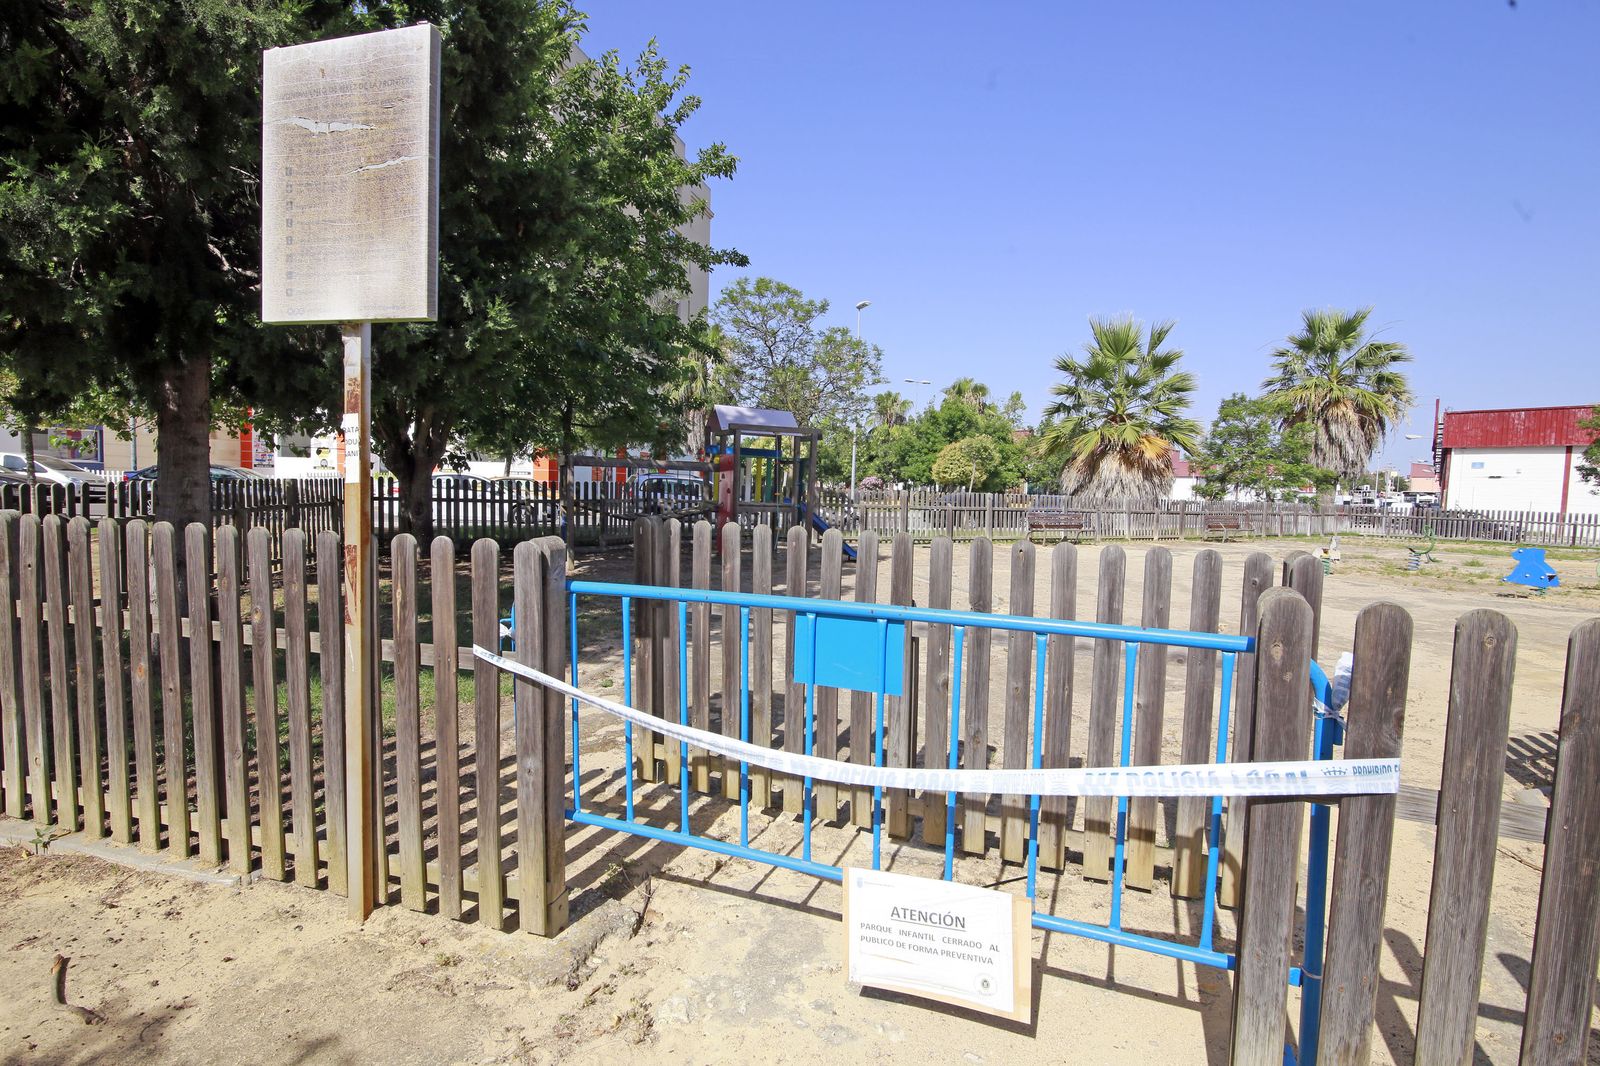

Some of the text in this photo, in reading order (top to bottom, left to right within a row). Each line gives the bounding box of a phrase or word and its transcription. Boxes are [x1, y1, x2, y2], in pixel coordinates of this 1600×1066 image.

[891, 906, 966, 929] ATENCIÓN
[860, 922, 1000, 952] PARQUE INFANTIL CERRADO AL
[860, 935, 993, 965] PUBLICO DE FORMA PREVENTIVA
